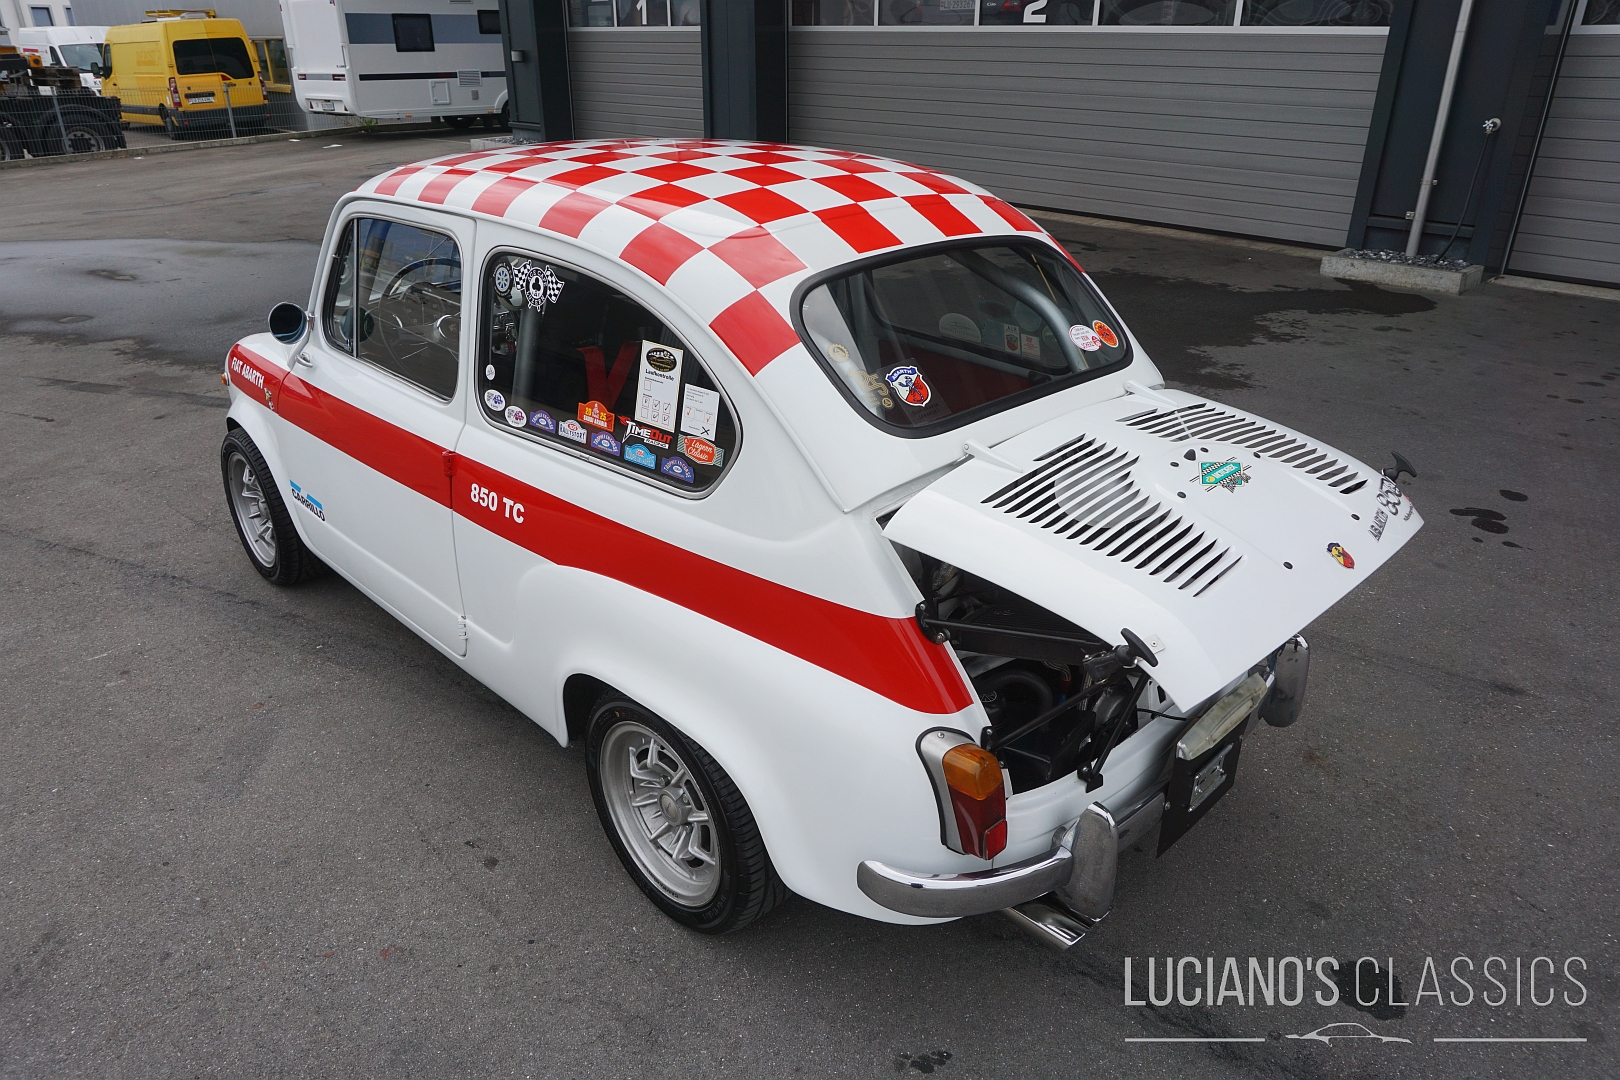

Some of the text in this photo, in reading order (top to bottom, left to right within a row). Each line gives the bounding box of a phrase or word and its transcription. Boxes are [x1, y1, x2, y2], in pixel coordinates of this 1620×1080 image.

[231, 356, 265, 389] FIAT ABARTH
[892, 369, 912, 380] ABARTH
[291, 488, 325, 521] CARRILLO
[471, 483, 525, 523] 850 TC
